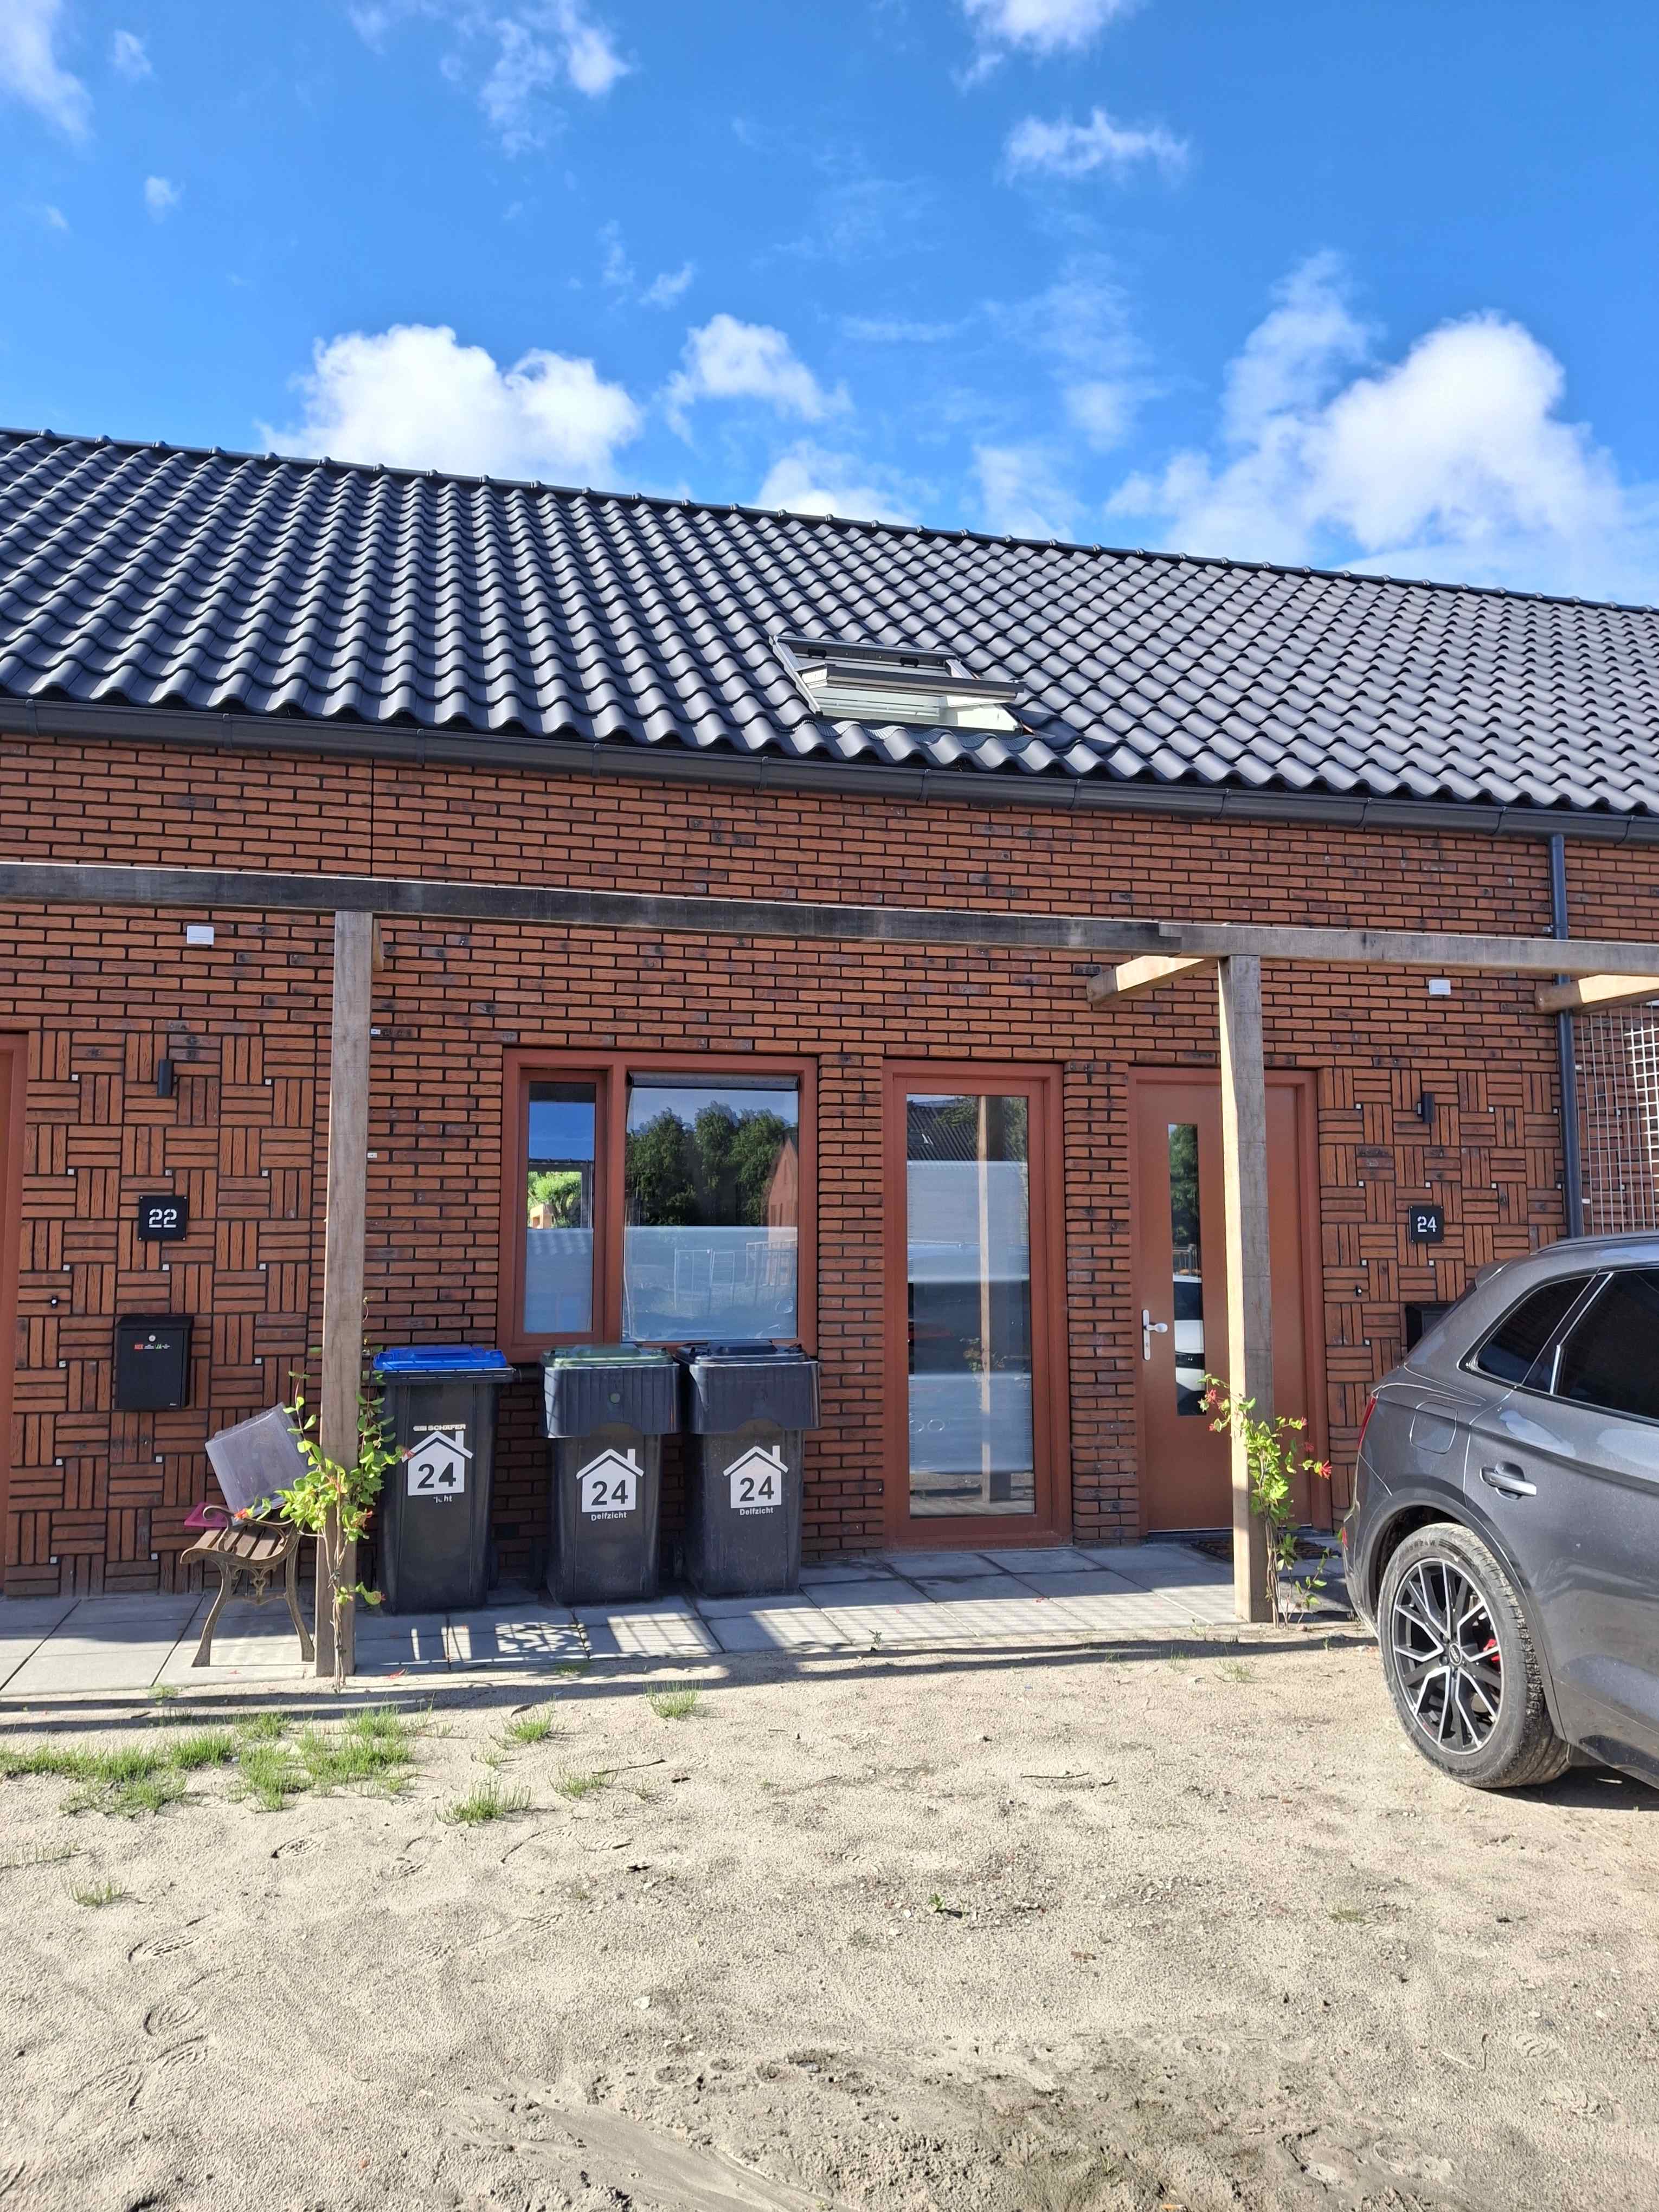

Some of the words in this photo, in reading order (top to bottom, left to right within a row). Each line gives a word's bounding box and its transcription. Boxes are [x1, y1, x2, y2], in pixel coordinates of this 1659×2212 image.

[149, 1209, 177, 1228] 22
[1417, 1216, 1437, 1232] 24
[417, 1462, 456, 1489] 24
[591, 1480, 628, 1506] 24
[740, 1476, 774, 1502] 24
[591, 1512, 627, 1521] Delfzicht
[740, 1507, 774, 1516] Delfzicht
